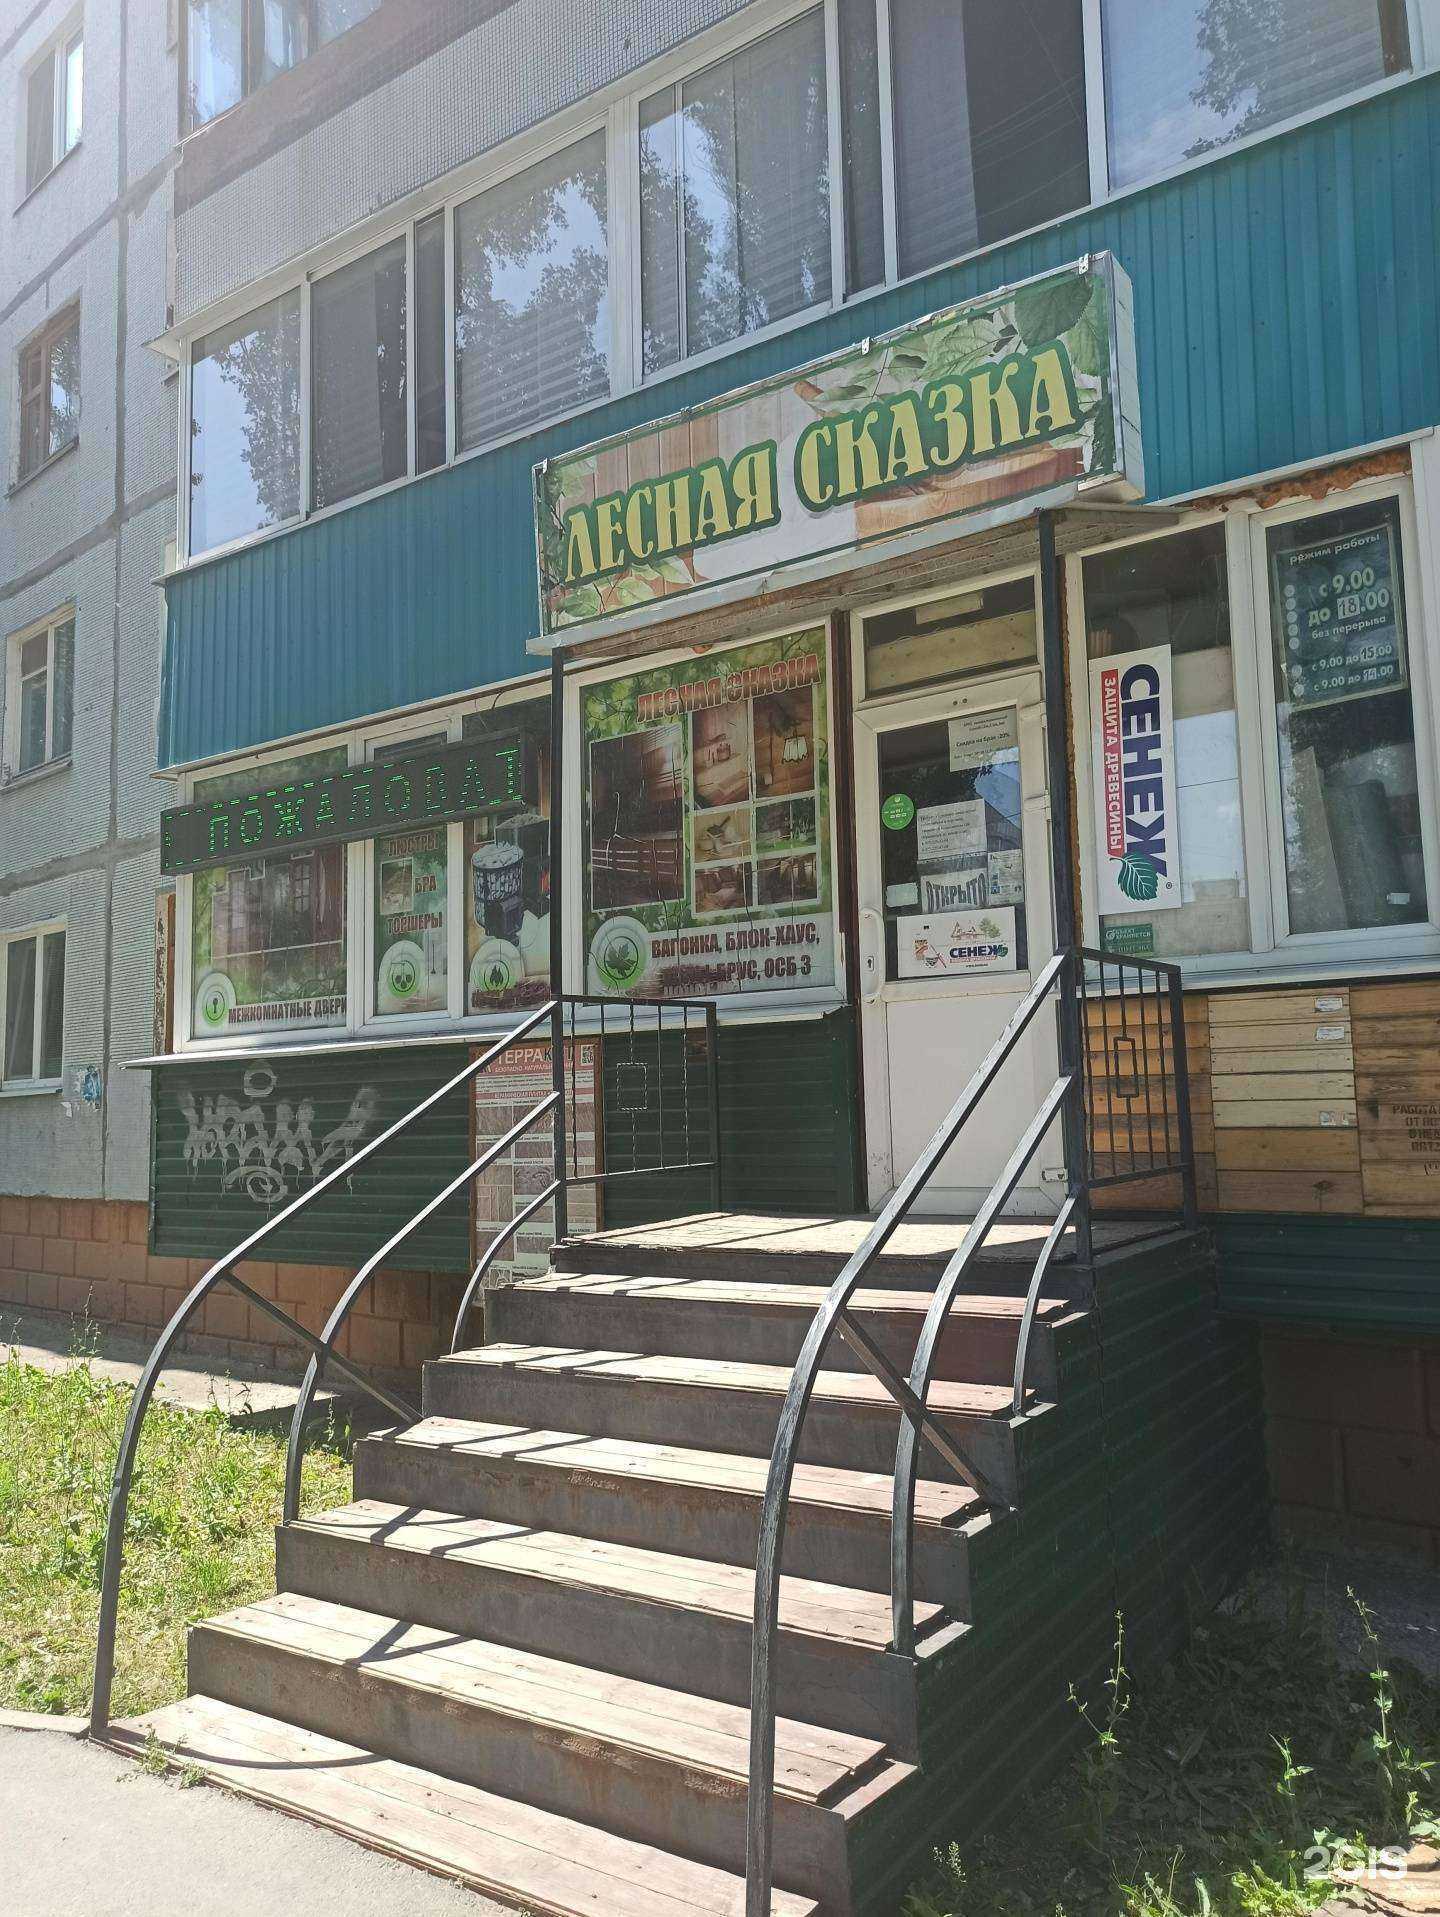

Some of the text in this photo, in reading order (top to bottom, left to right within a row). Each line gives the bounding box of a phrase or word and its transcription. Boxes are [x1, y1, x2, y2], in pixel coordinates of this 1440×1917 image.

[563, 347, 1078, 585] ЛЕСНАЯ СКАЗКА
[1289, 533, 1381, 566] режим работы
[1319, 566, 1375, 598] с 9.00
[1308, 588, 1390, 628] до 18.00
[1311, 615, 1386, 640] без перерыва
[1319, 656, 1343, 670] 9.00
[636, 653, 822, 724] ЛЕСНАЯ СКАЗКА
[1321, 676, 1346, 690] 9.00
[1103, 676, 1123, 851] ЗАЩИТА ДРЕВЕСИНЫ
[1120, 663, 1168, 879] СЕНЕЖ
[415, 874, 437, 894] БРА
[925, 872, 987, 914] ОТКРЫТО
[388, 911, 443, 936] ТОРШЕРЫ
[651, 922, 820, 959] ВАГОНКА, БЛОК-ХАУС,
[764, 955, 797, 979] ОСБ
[800, 954, 812, 976] 3
[228, 1001, 312, 1025] МЕЖКОМНАТНЫЕ
